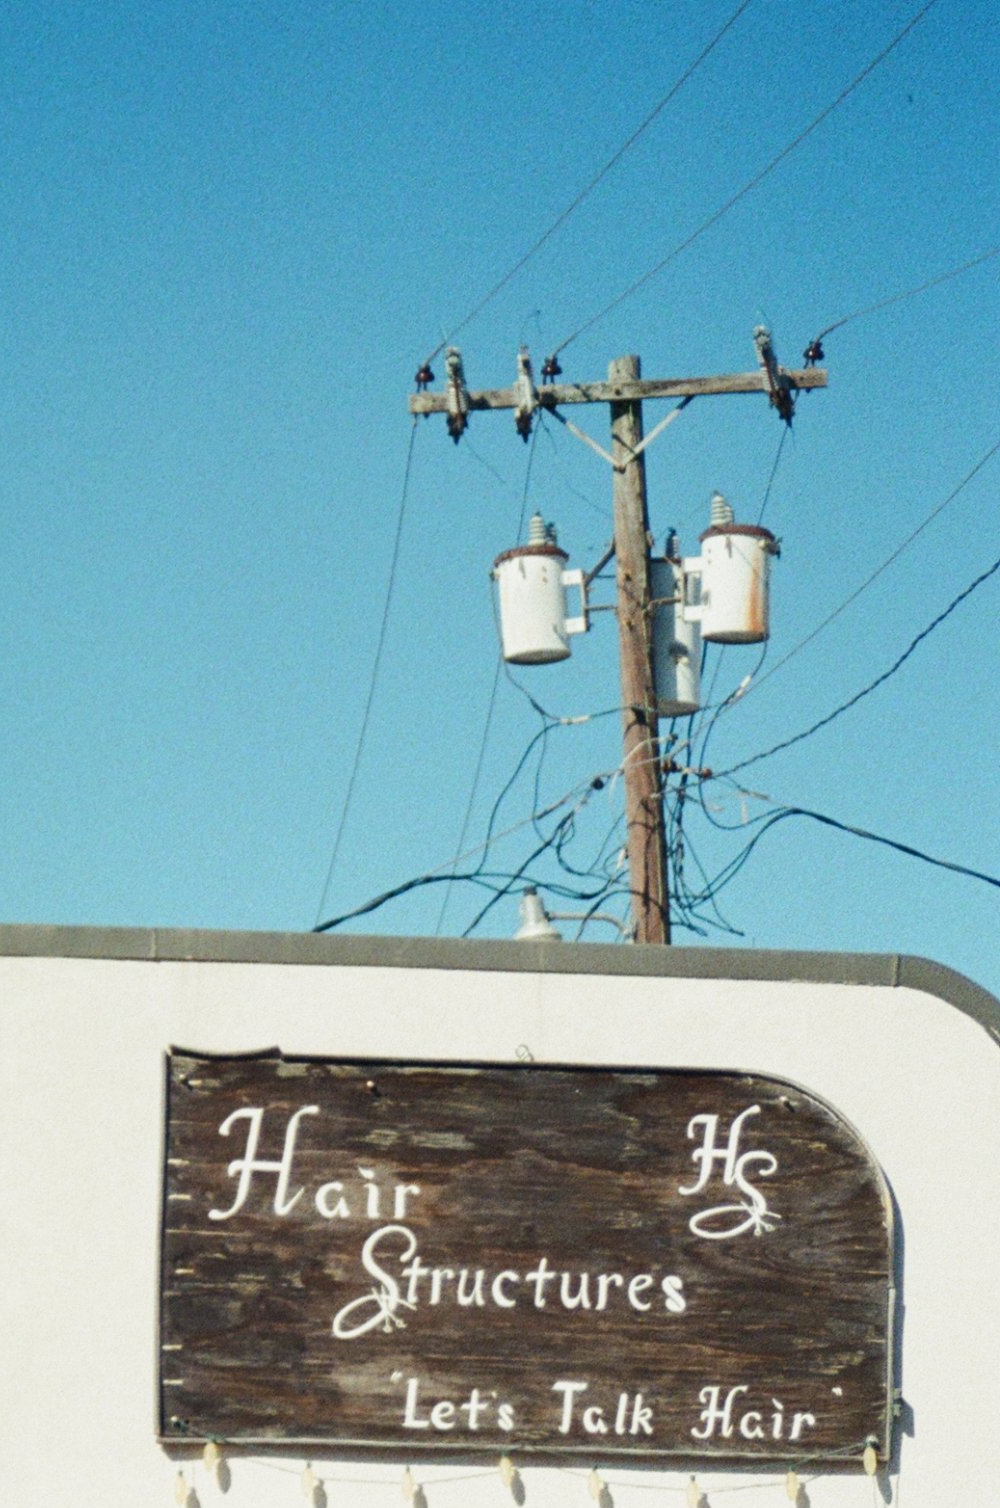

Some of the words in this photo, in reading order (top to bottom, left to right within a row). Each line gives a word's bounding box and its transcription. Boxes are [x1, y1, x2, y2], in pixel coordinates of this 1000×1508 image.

[208, 1105, 422, 1221] Hair
[332, 1225, 687, 1340] Structures
[551, 1380, 654, 1436] Talk
